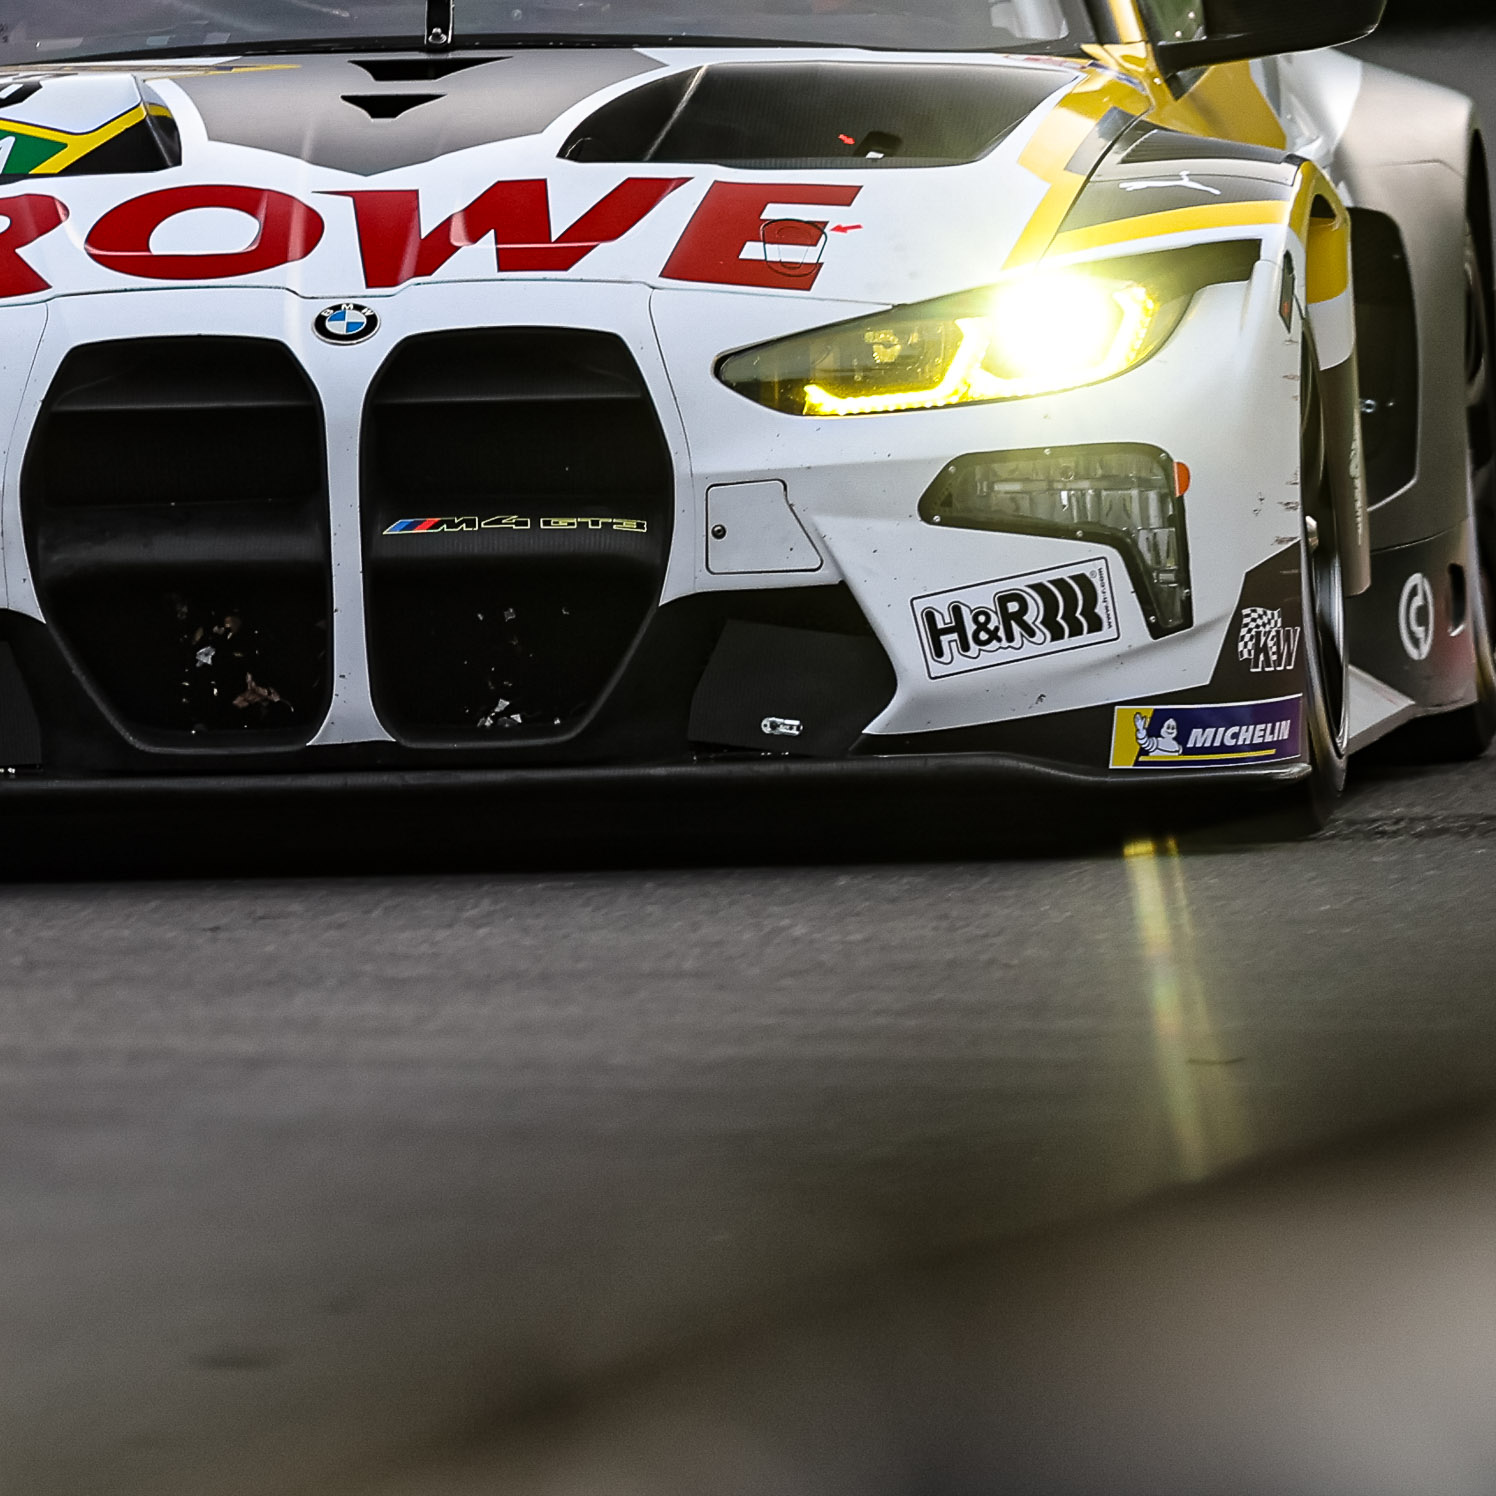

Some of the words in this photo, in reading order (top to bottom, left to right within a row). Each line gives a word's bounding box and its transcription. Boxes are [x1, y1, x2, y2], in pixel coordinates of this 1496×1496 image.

[433, 515, 531, 533] M4
[539, 516, 648, 533] GT3
[924, 591, 1039, 660] H&R
[1249, 626, 1301, 673] KW
[1185, 719, 1292, 748] MICHELIN
